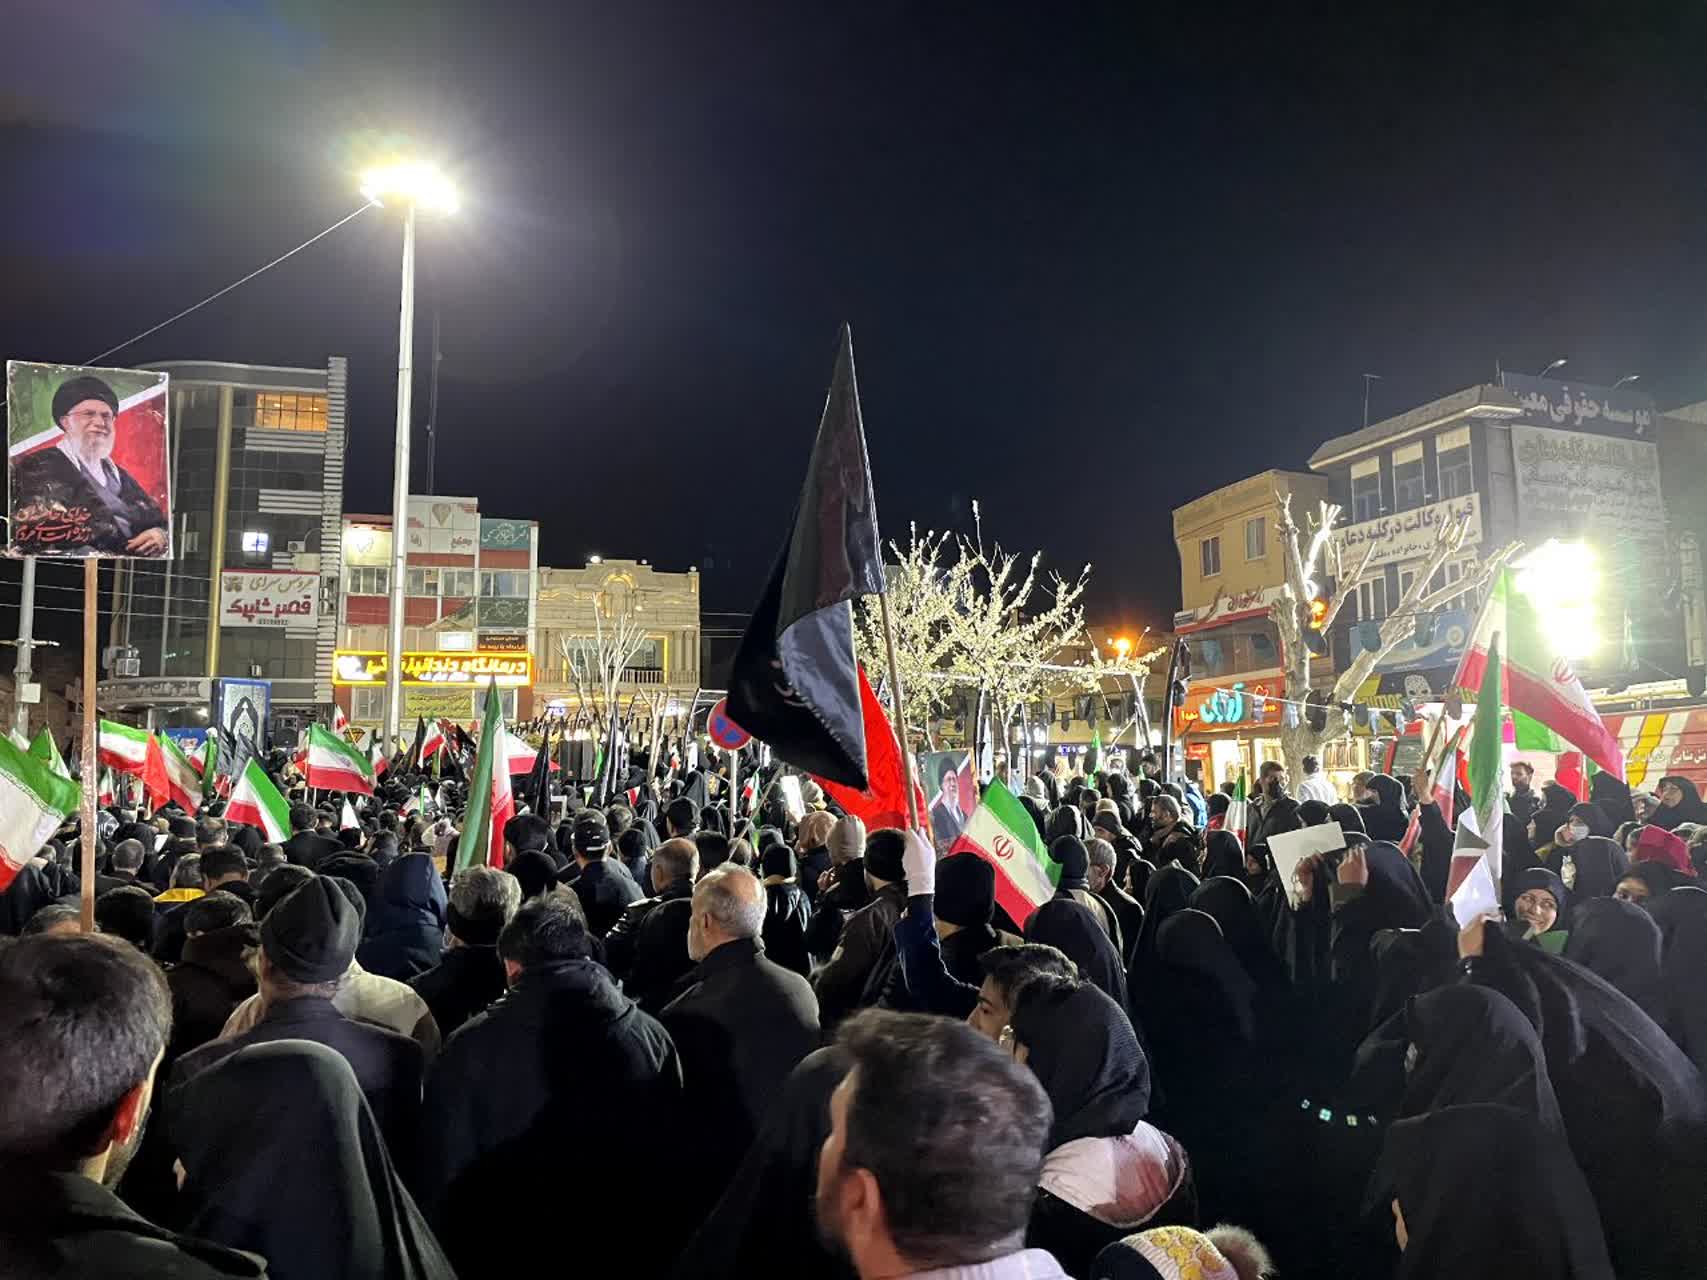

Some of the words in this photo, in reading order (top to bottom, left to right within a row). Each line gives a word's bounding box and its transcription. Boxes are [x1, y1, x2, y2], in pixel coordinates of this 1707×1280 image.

[1551, 385, 1600, 425] حقوقی
[247, 576, 283, 592] سرای
[278, 576, 314, 593] عروس
[365, 655, 459, 678] دندانپزکی
[462, 656, 526, 674] درمانگاه
